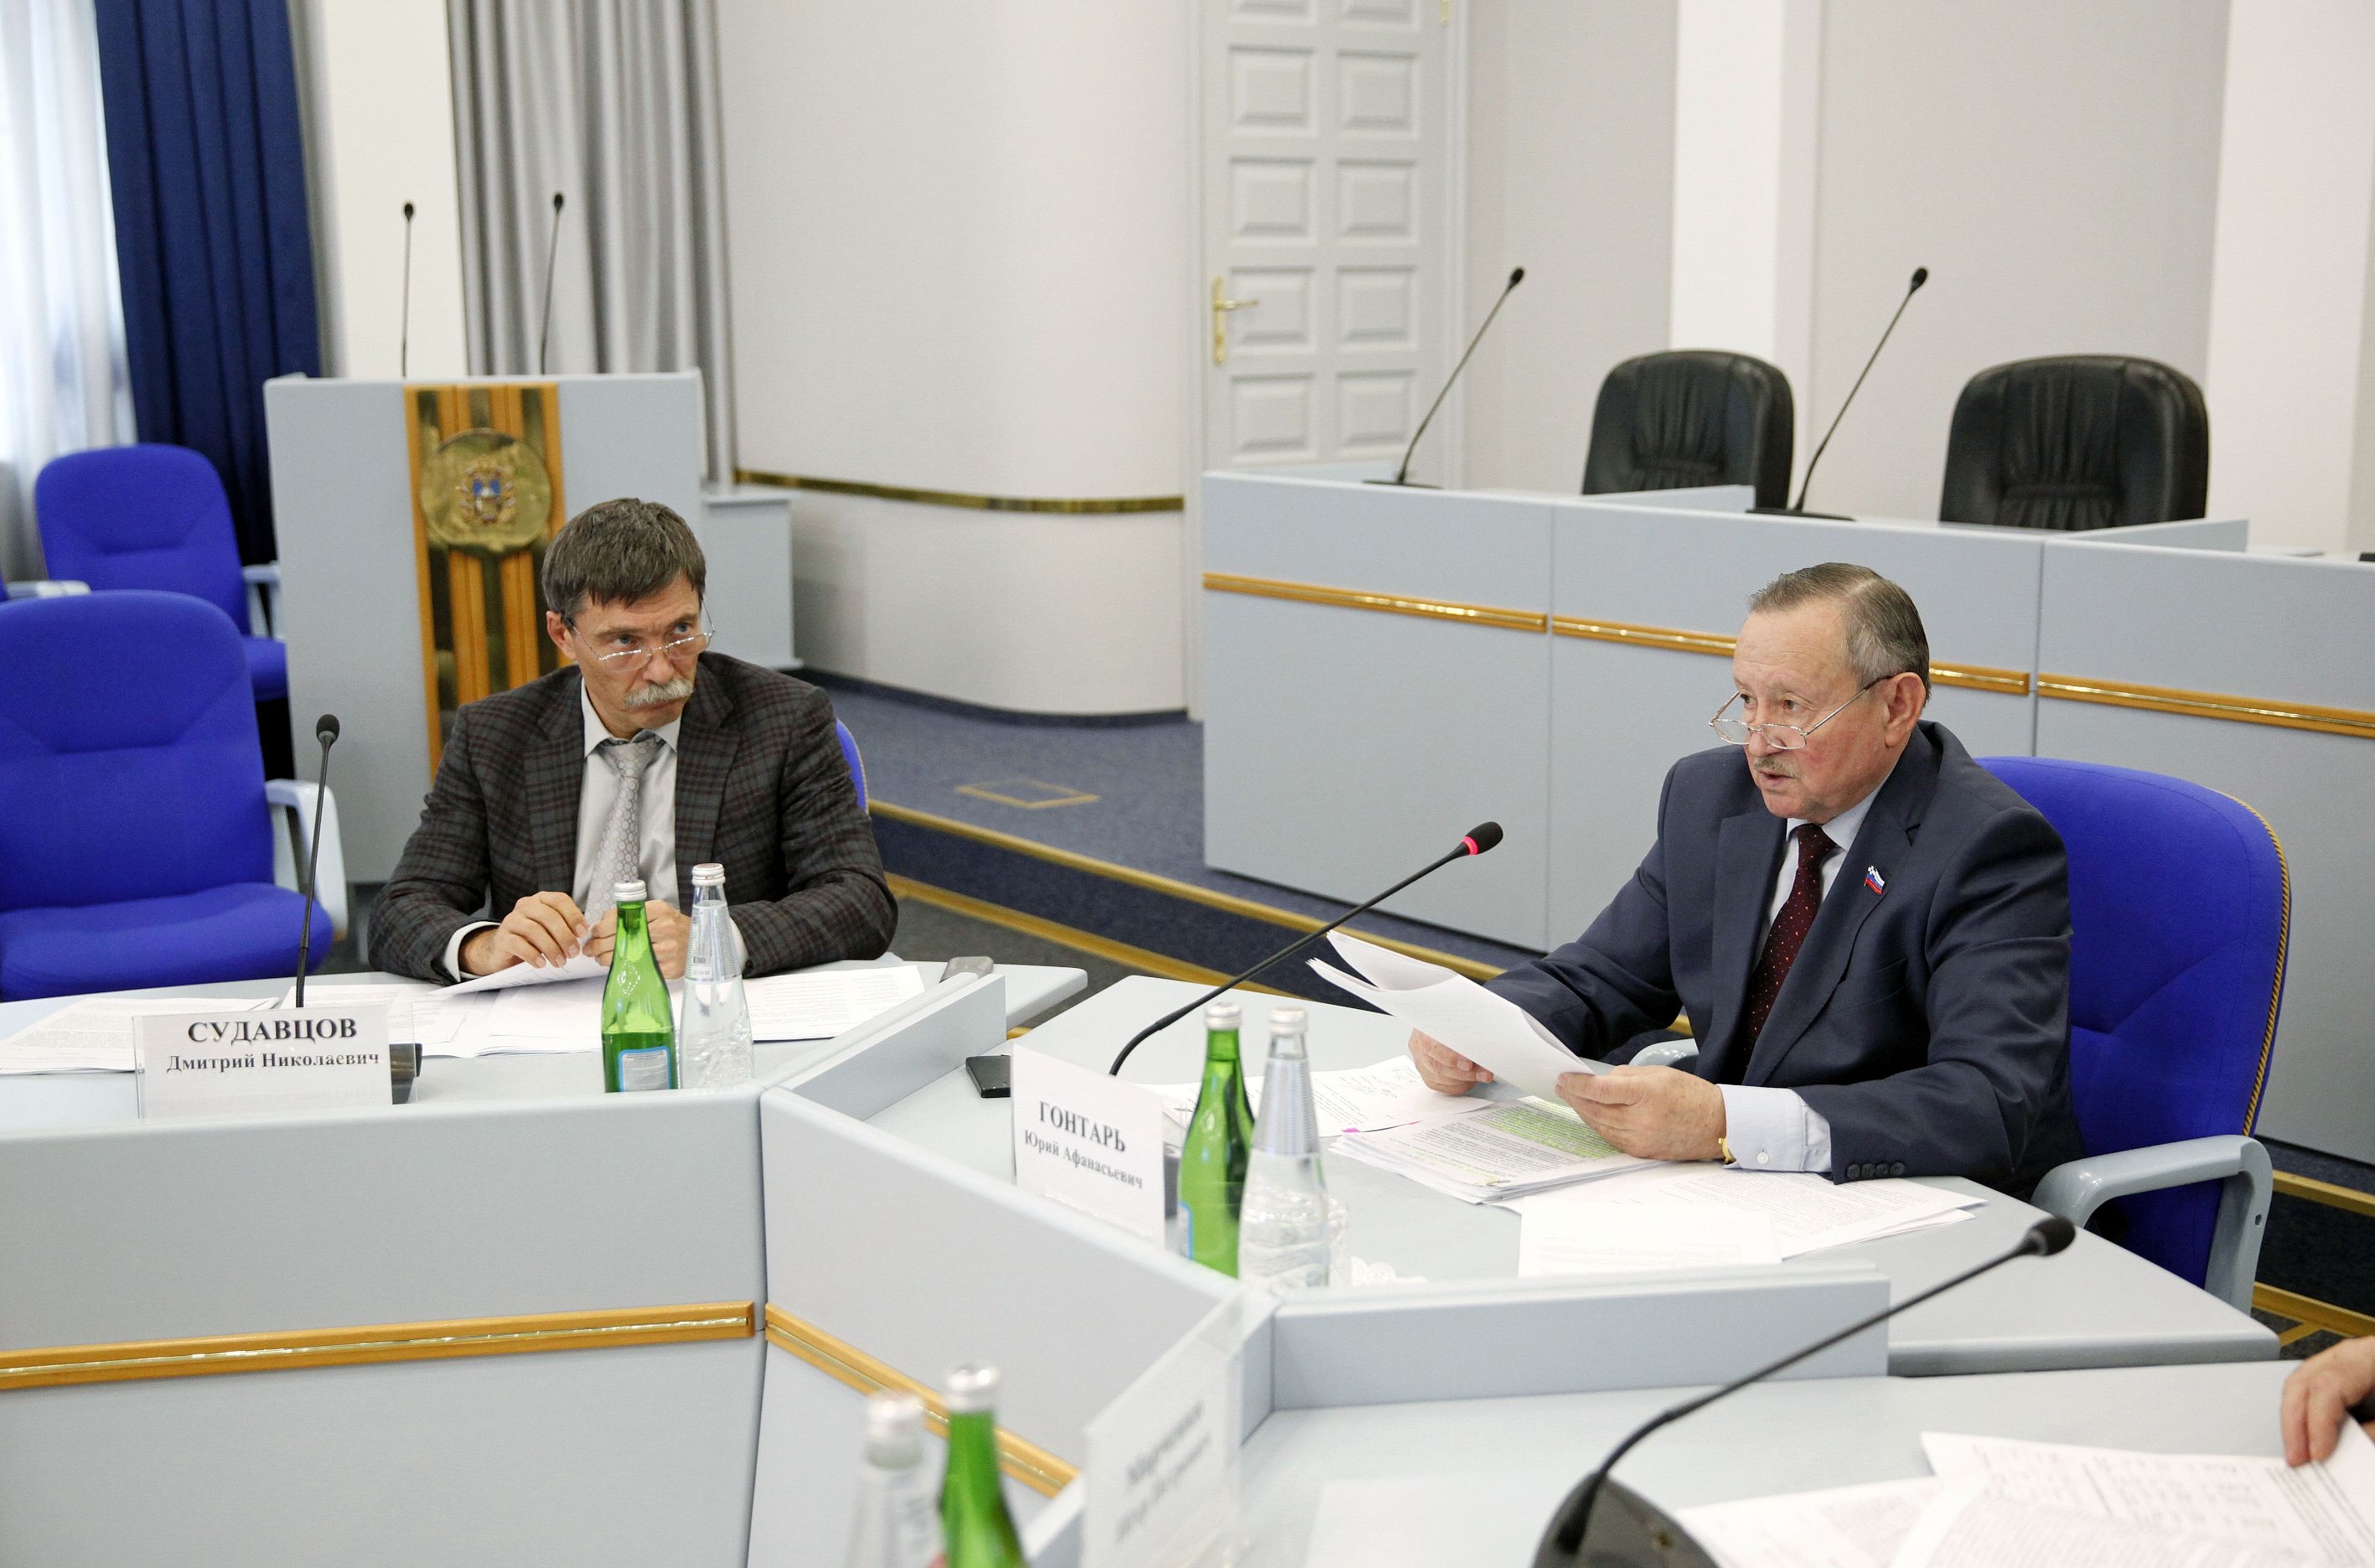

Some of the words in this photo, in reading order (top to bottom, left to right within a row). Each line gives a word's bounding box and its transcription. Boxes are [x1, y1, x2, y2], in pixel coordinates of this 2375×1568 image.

[188, 1017, 357, 1046] СУДАВЦОВ
[167, 1053, 255, 1073] Дмитрий
[261, 1052, 380, 1068] Николаевич
[1039, 1101, 1125, 1152] ГОНТАРЬ
[1025, 1130, 1059, 1156] Юрий
[1063, 1146, 1143, 1189] Афанасьевич
